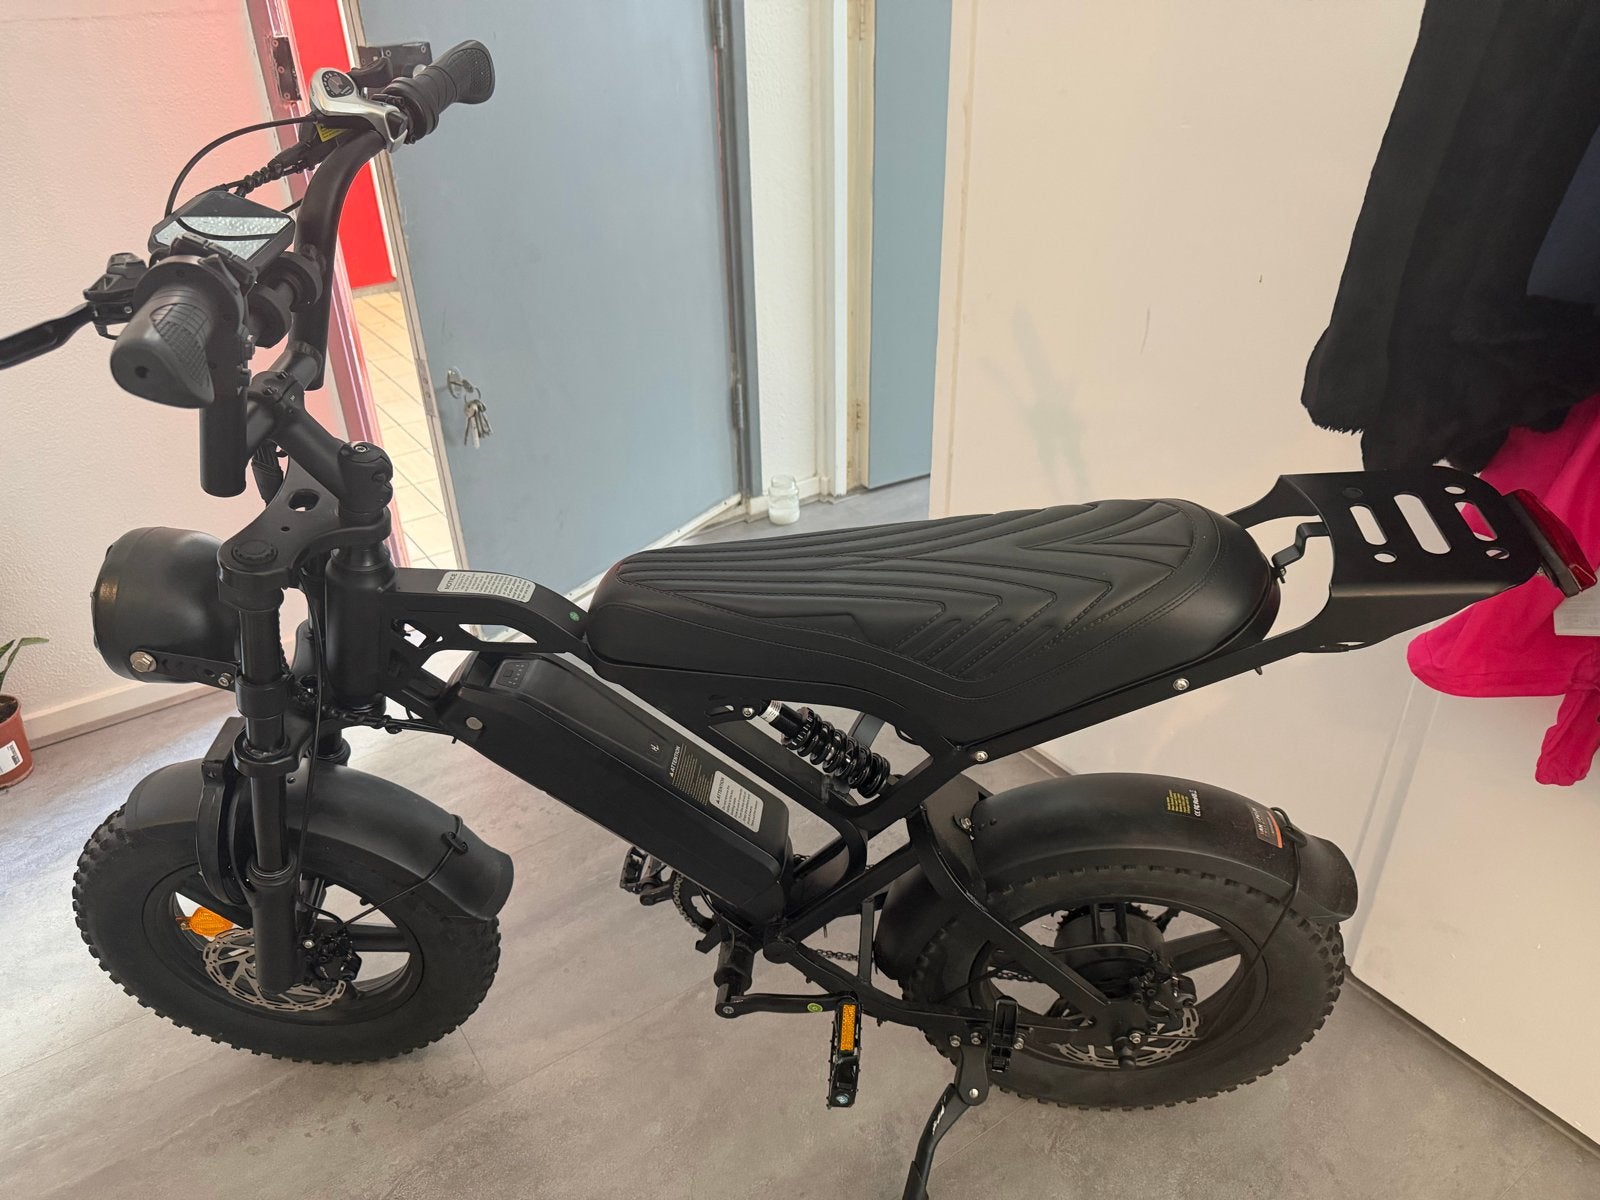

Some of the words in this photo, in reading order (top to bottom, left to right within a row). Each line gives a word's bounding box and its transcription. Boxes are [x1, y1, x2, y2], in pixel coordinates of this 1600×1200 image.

[444, 573, 458, 590] NOTICE
[670, 745, 681, 773] ATTENTION
[715, 777, 725, 799] ATTENTION
